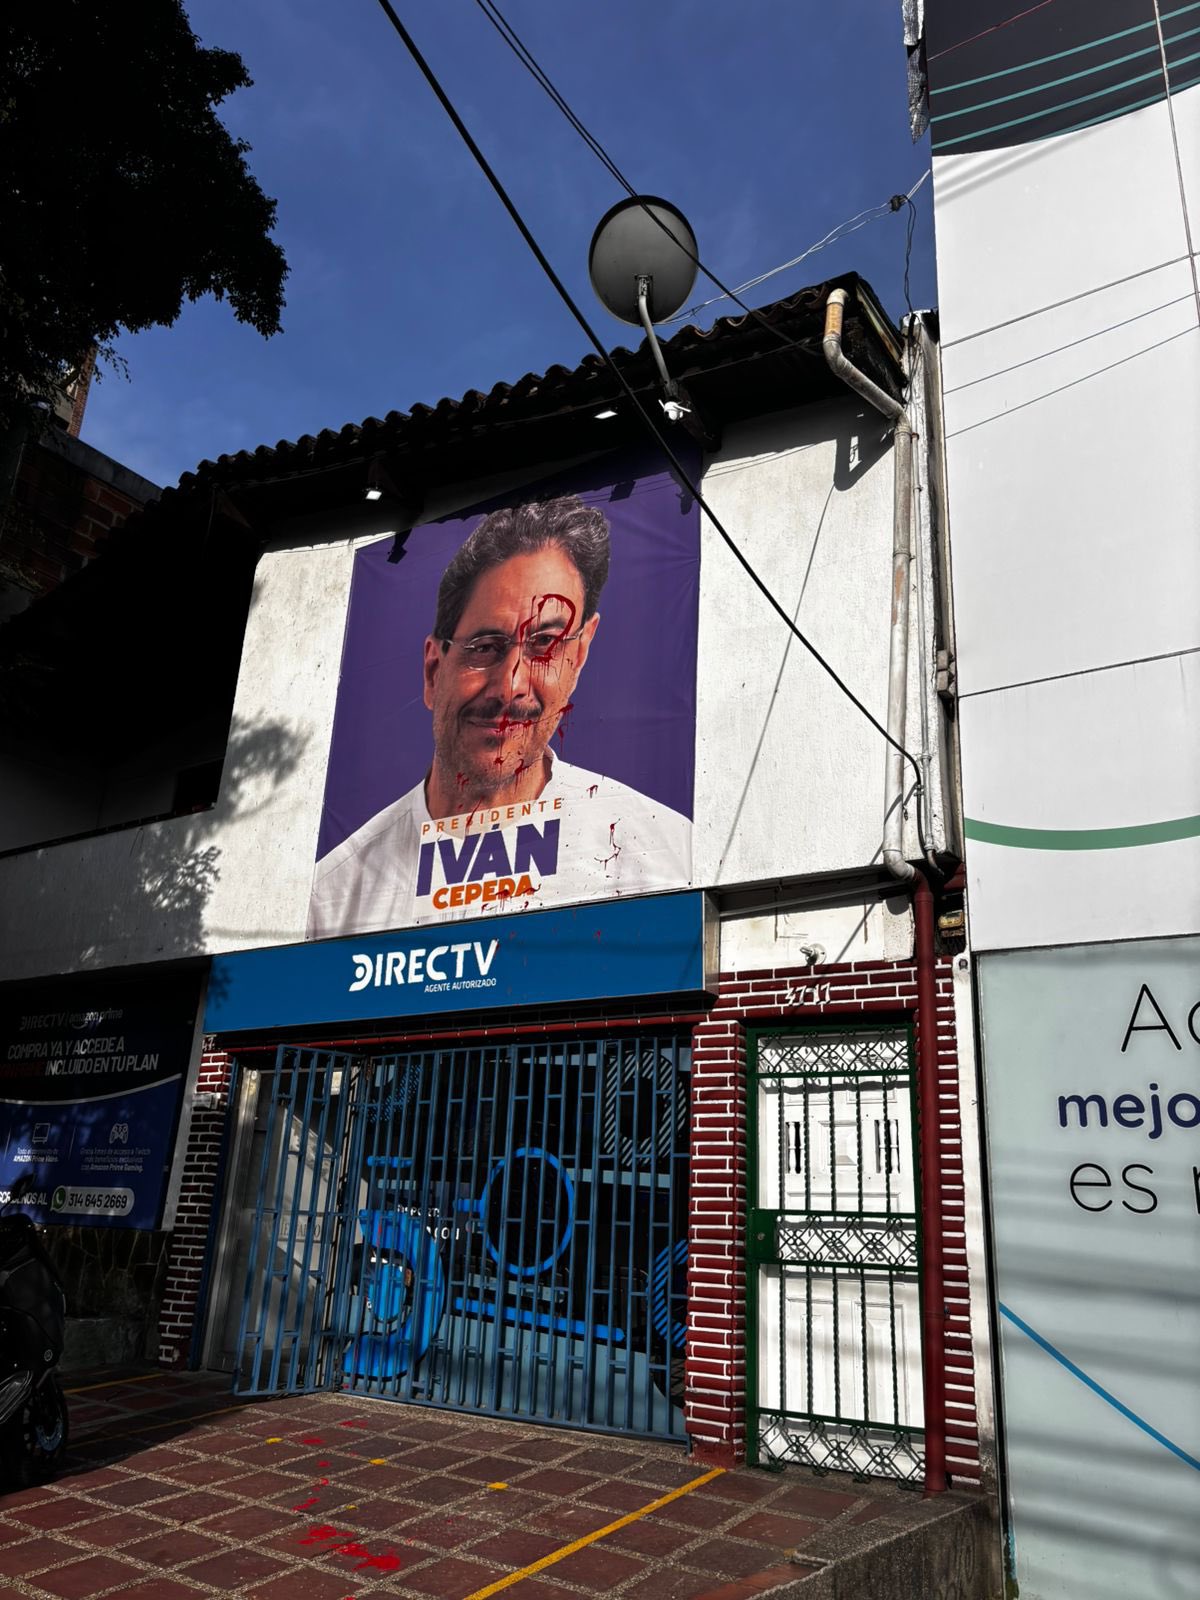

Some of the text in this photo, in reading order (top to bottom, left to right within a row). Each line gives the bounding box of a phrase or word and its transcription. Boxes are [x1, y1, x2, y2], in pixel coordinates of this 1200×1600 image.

[422, 797, 562, 835] PRESIDENTE
[416, 818, 560, 897] IVÁN
[432, 874, 535, 909] CEPEDA
[349, 939, 499, 992] DIRECTV
[424, 977, 497, 993] AGENTE AUTORIZADO
[19, 1013, 65, 1031] DIRECTV
[8, 1035, 125, 1060] COMPRA YA Y ACCEDE A
[44, 1057, 94, 1077] INCLUIDO
[94, 1056, 110, 1074] EN
[110, 1054, 126, 1073] TU
[125, 1053, 160, 1072] PLAN
[68, 1193, 128, 1209] 314 645 2669
[1070, 1163, 1158, 1214] es
